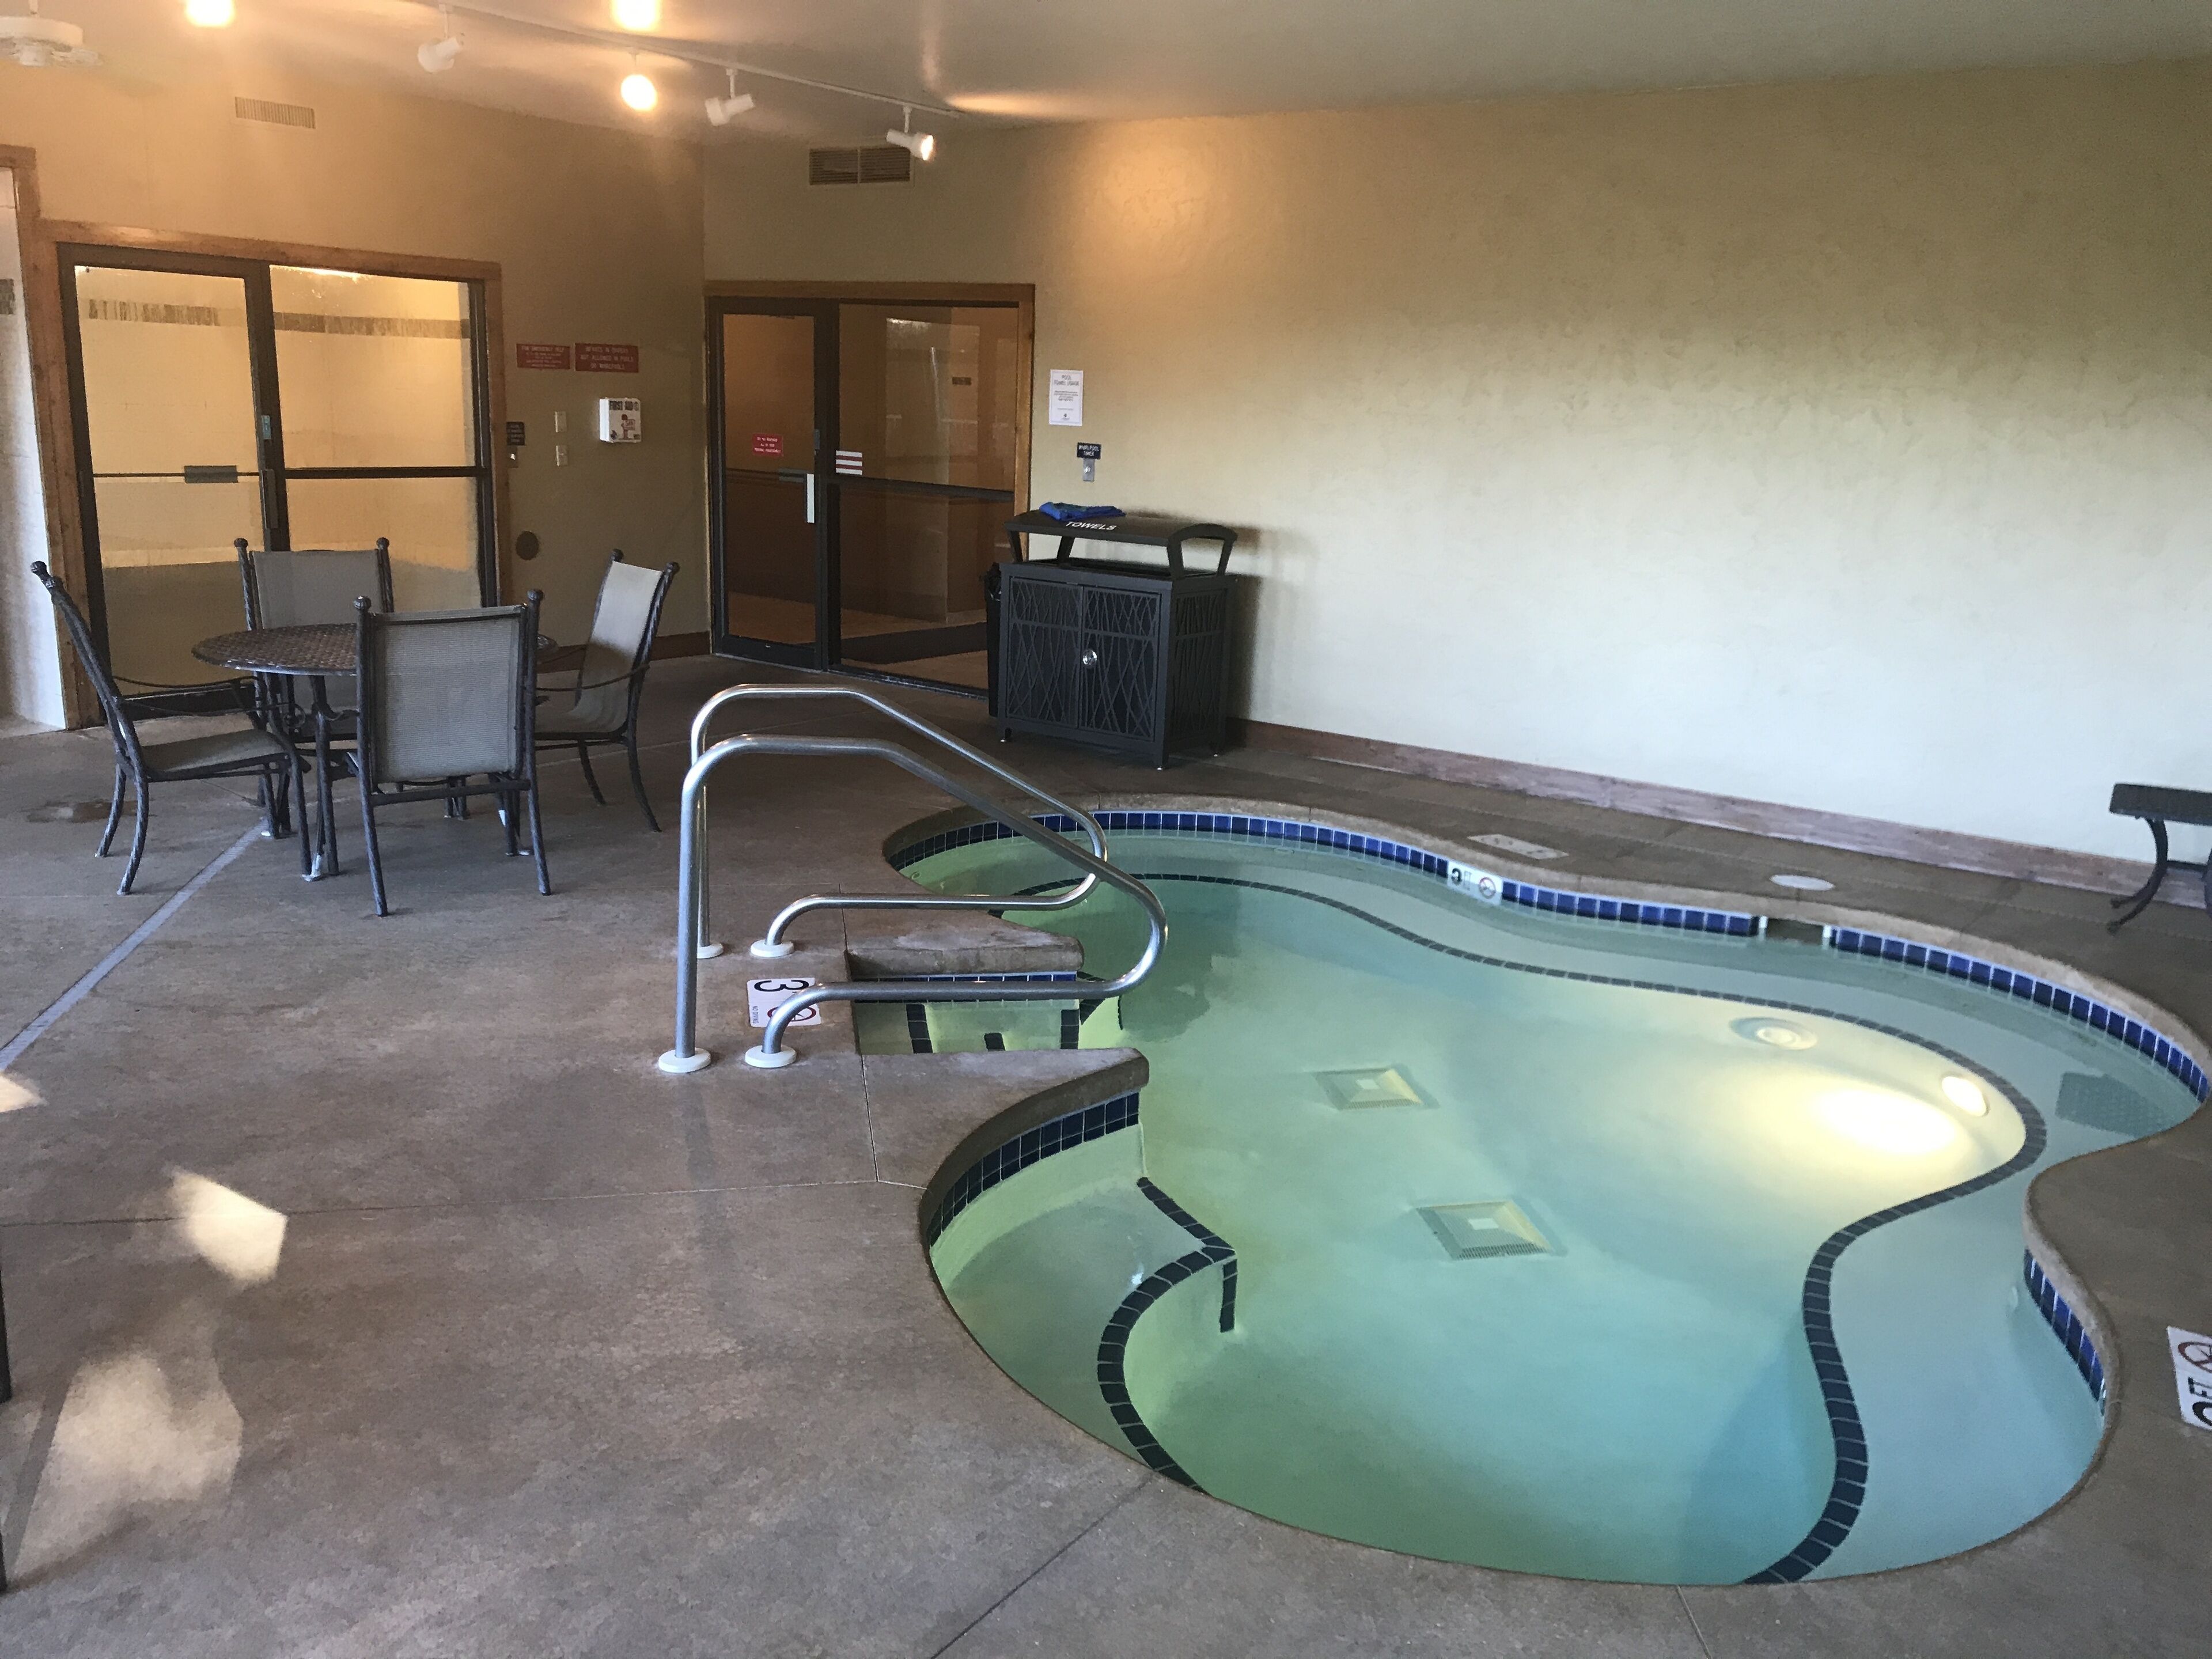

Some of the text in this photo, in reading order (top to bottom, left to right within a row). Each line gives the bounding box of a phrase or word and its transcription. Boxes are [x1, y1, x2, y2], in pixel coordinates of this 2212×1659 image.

[609, 401, 623, 410] FIRST
[1065, 520, 1118, 531] TOWELS
[753, 979, 809, 993] 3
